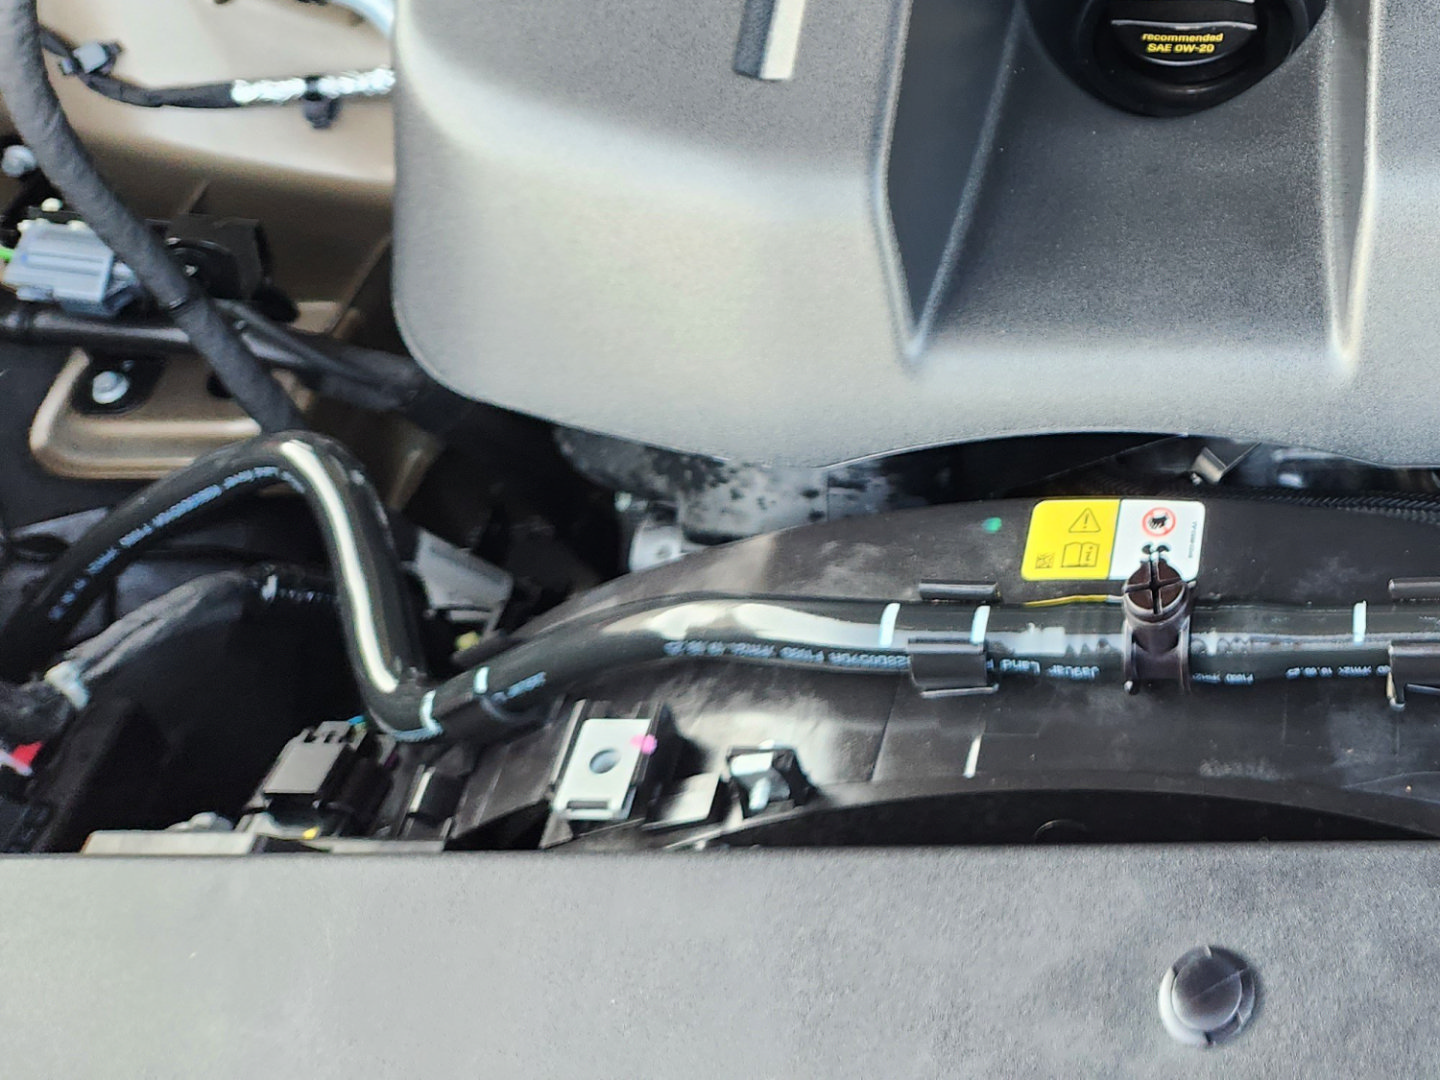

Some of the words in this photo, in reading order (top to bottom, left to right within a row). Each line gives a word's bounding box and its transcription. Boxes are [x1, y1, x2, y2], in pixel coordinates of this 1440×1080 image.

[1142, 33, 1224, 43] recommended
[1146, 43, 1173, 53] SAE
[1174, 43, 1215, 53] 0W-20
